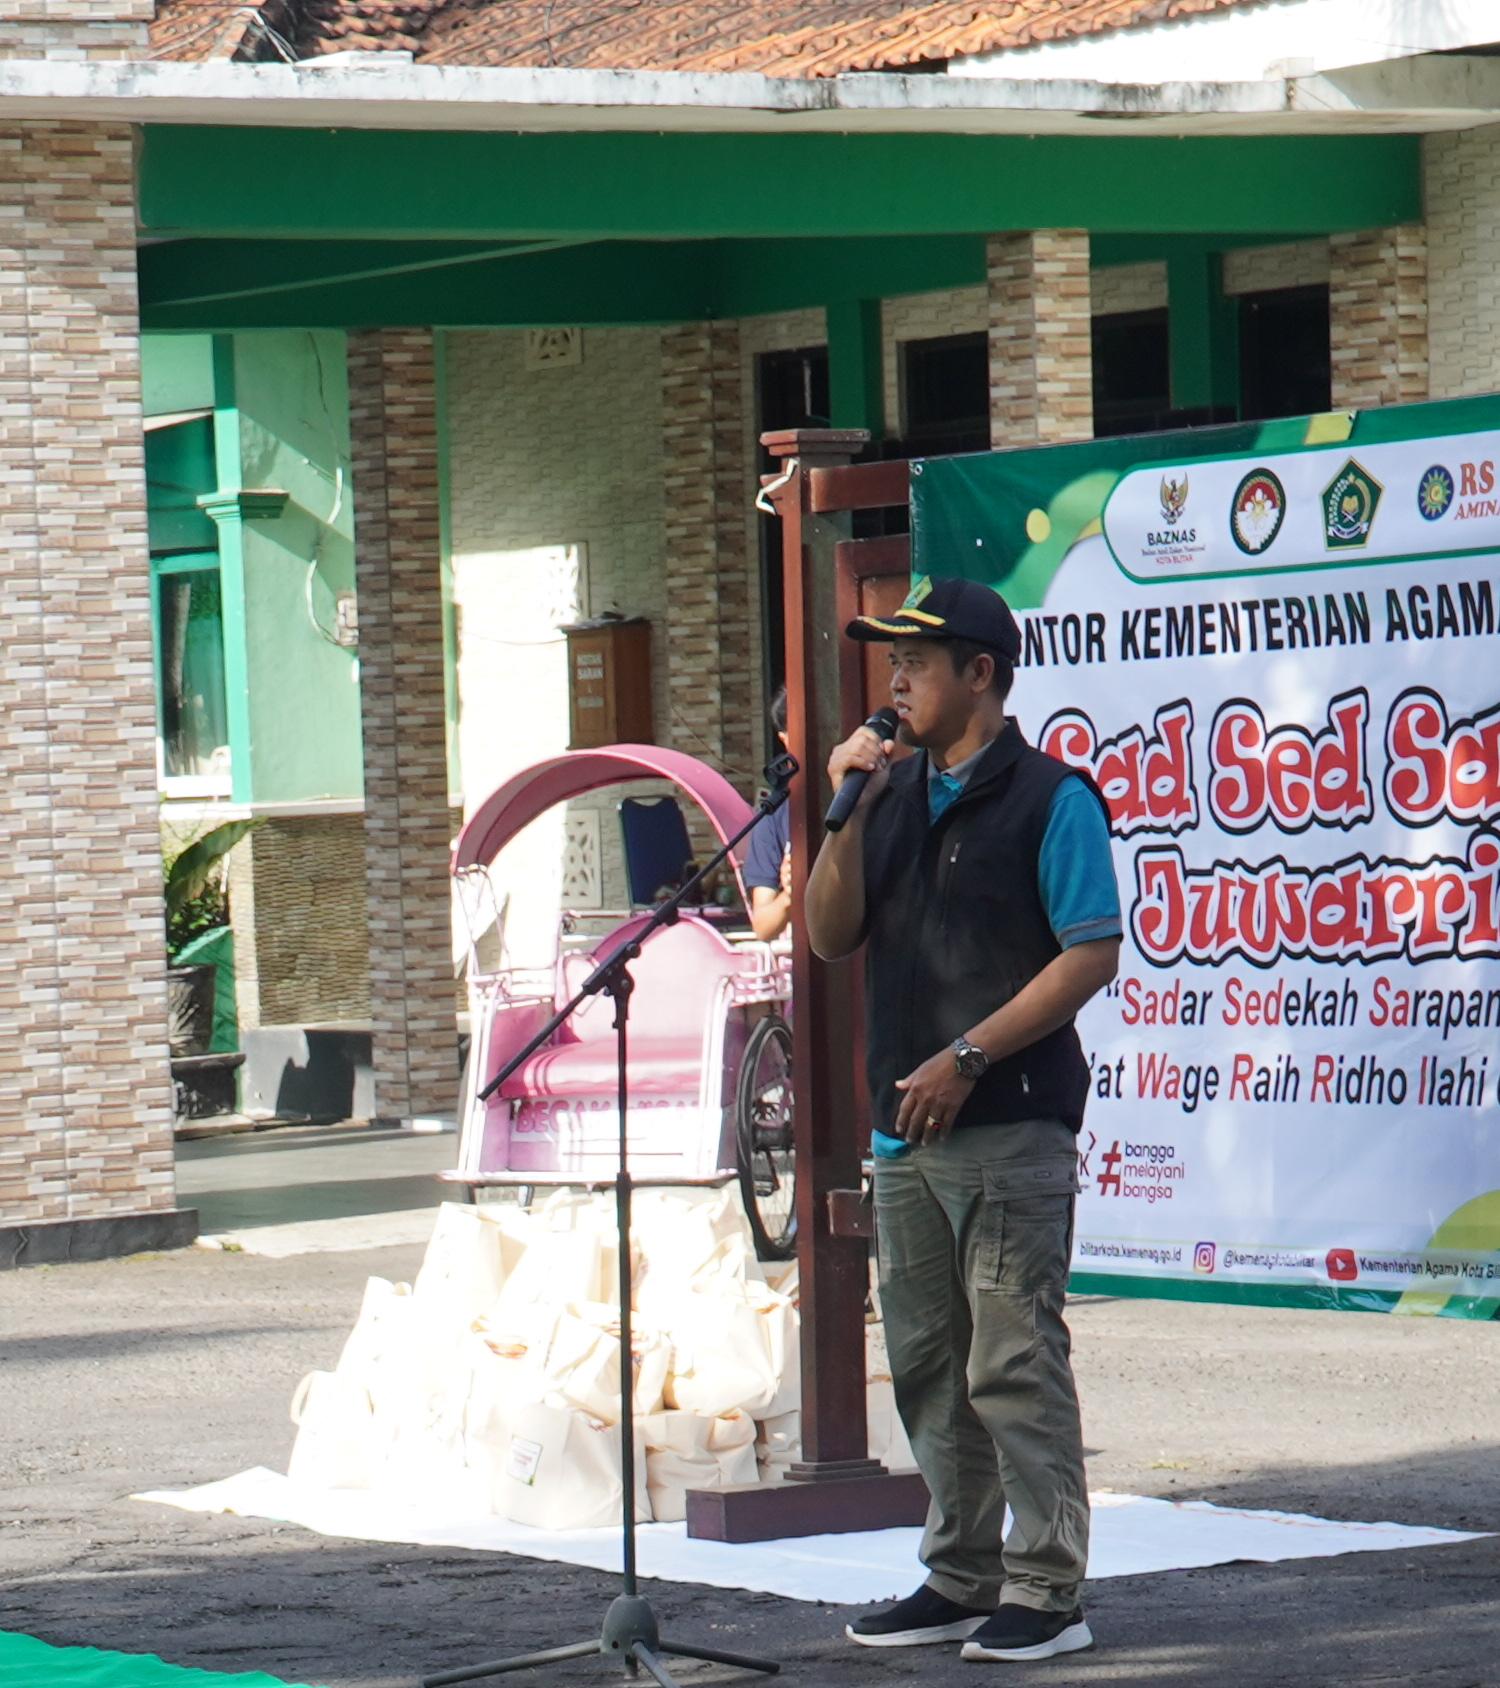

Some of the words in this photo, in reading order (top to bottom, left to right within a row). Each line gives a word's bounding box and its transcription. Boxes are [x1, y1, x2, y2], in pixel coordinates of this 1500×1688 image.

[1459, 460, 1496, 497] RS
[1147, 528, 1196, 547] BAZNAS
[1014, 613, 1106, 668] NTOR
[1120, 591, 1371, 662] KEMENTERIAN
[1208, 686, 1374, 835] Sed
[1221, 976, 1359, 1028] Sedekah
[1137, 1051, 1220, 1114] Wage
[1229, 1053, 1301, 1103] Raih
[1310, 1054, 1408, 1106] Ridho
[1417, 1054, 1489, 1108] Ilahi
[1125, 1141, 1175, 1164] bangga
[1123, 1162, 1185, 1184] melayani
[1123, 1181, 1173, 1204] bangsa
[1359, 1256, 1424, 1276] Kementerian
[1425, 1262, 1459, 1280] Agama
[1460, 1262, 1484, 1279] Kota
